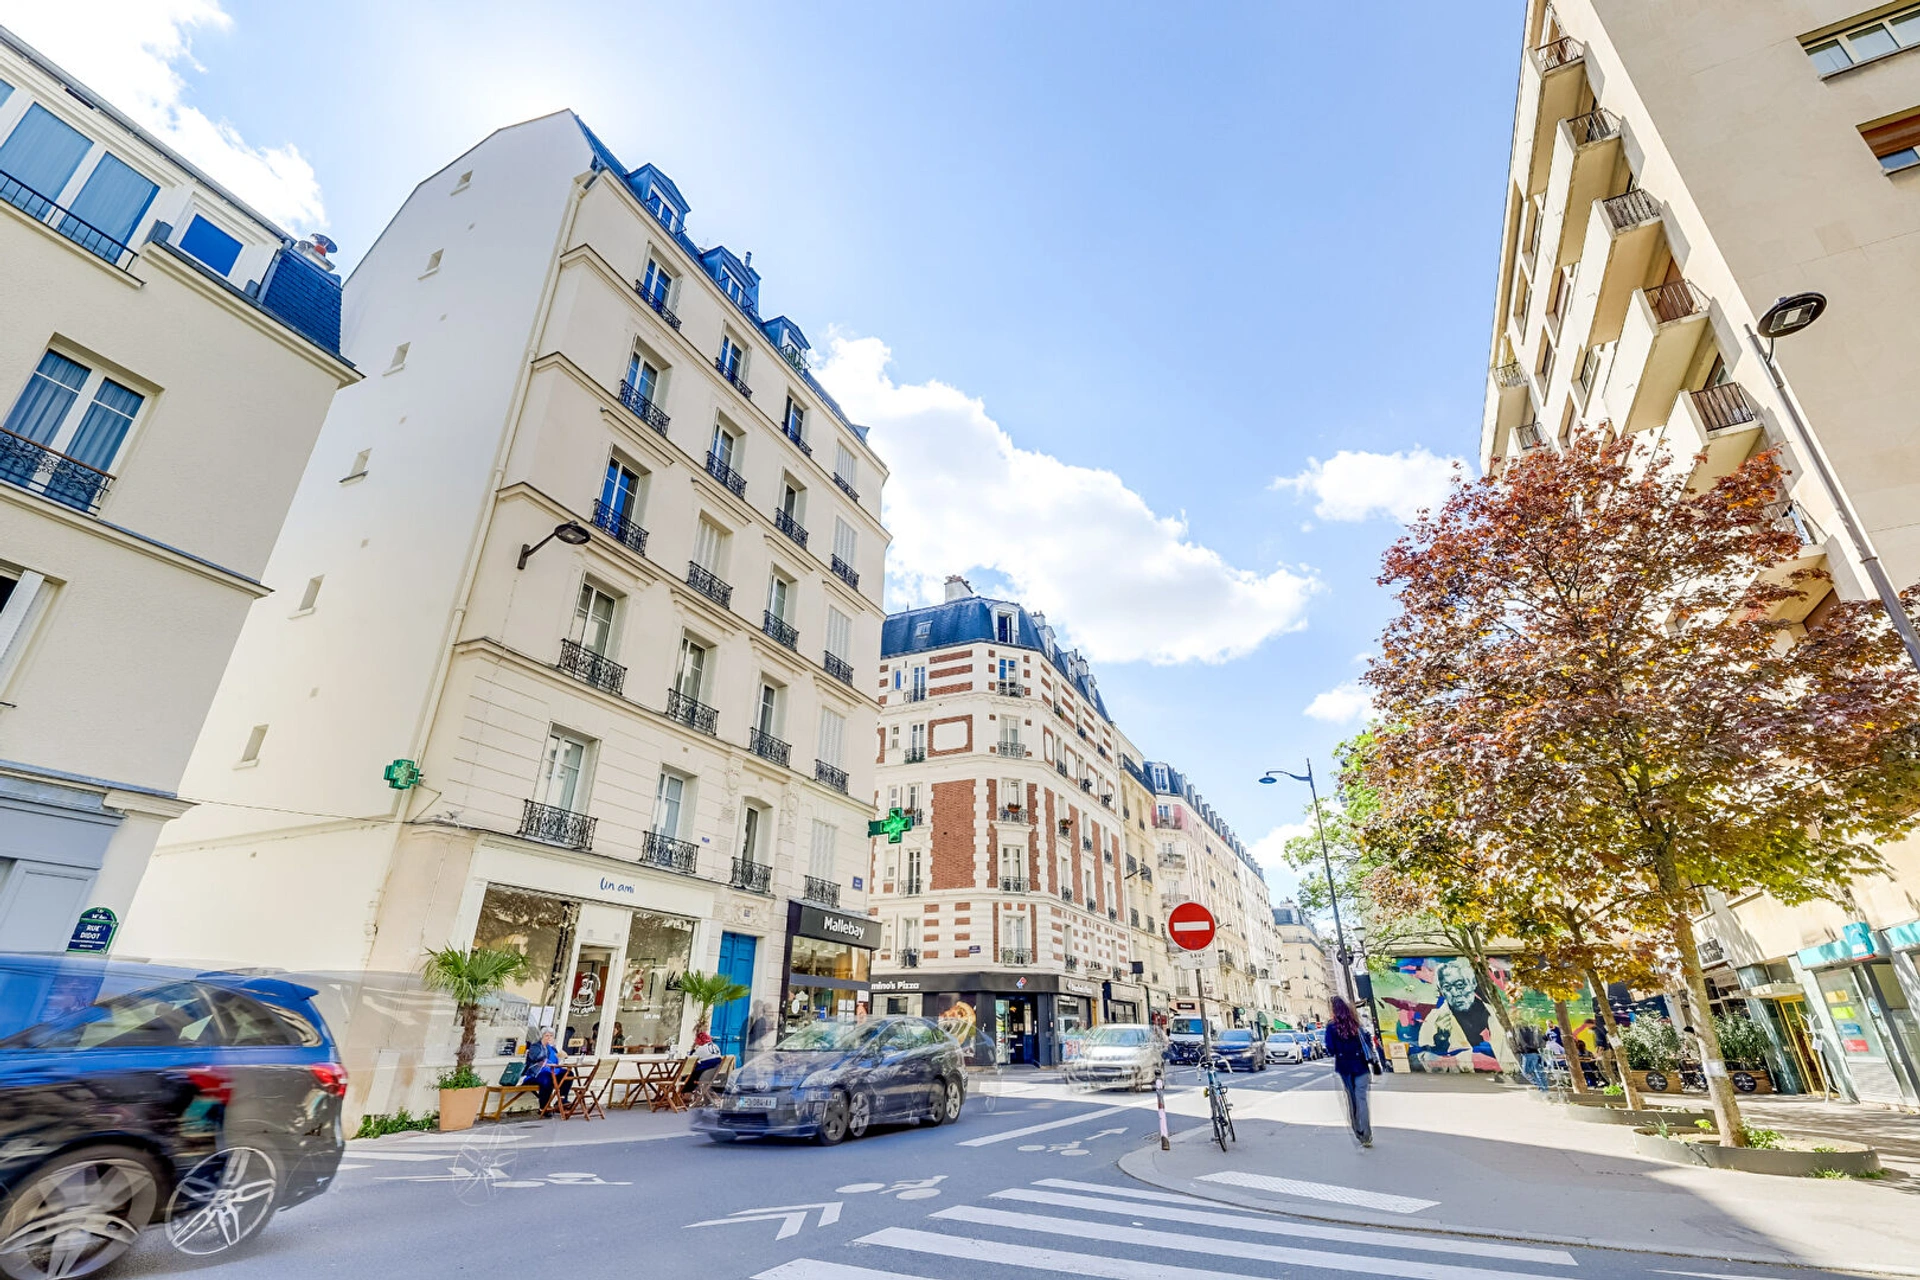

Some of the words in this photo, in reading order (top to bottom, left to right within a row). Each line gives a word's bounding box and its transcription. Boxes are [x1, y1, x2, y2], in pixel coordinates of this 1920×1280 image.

[617, 883, 636, 893] ami
[86, 924, 101, 932] RUE
[823, 916, 865, 939] Mallebay
[897, 981, 920, 989] Pizza
